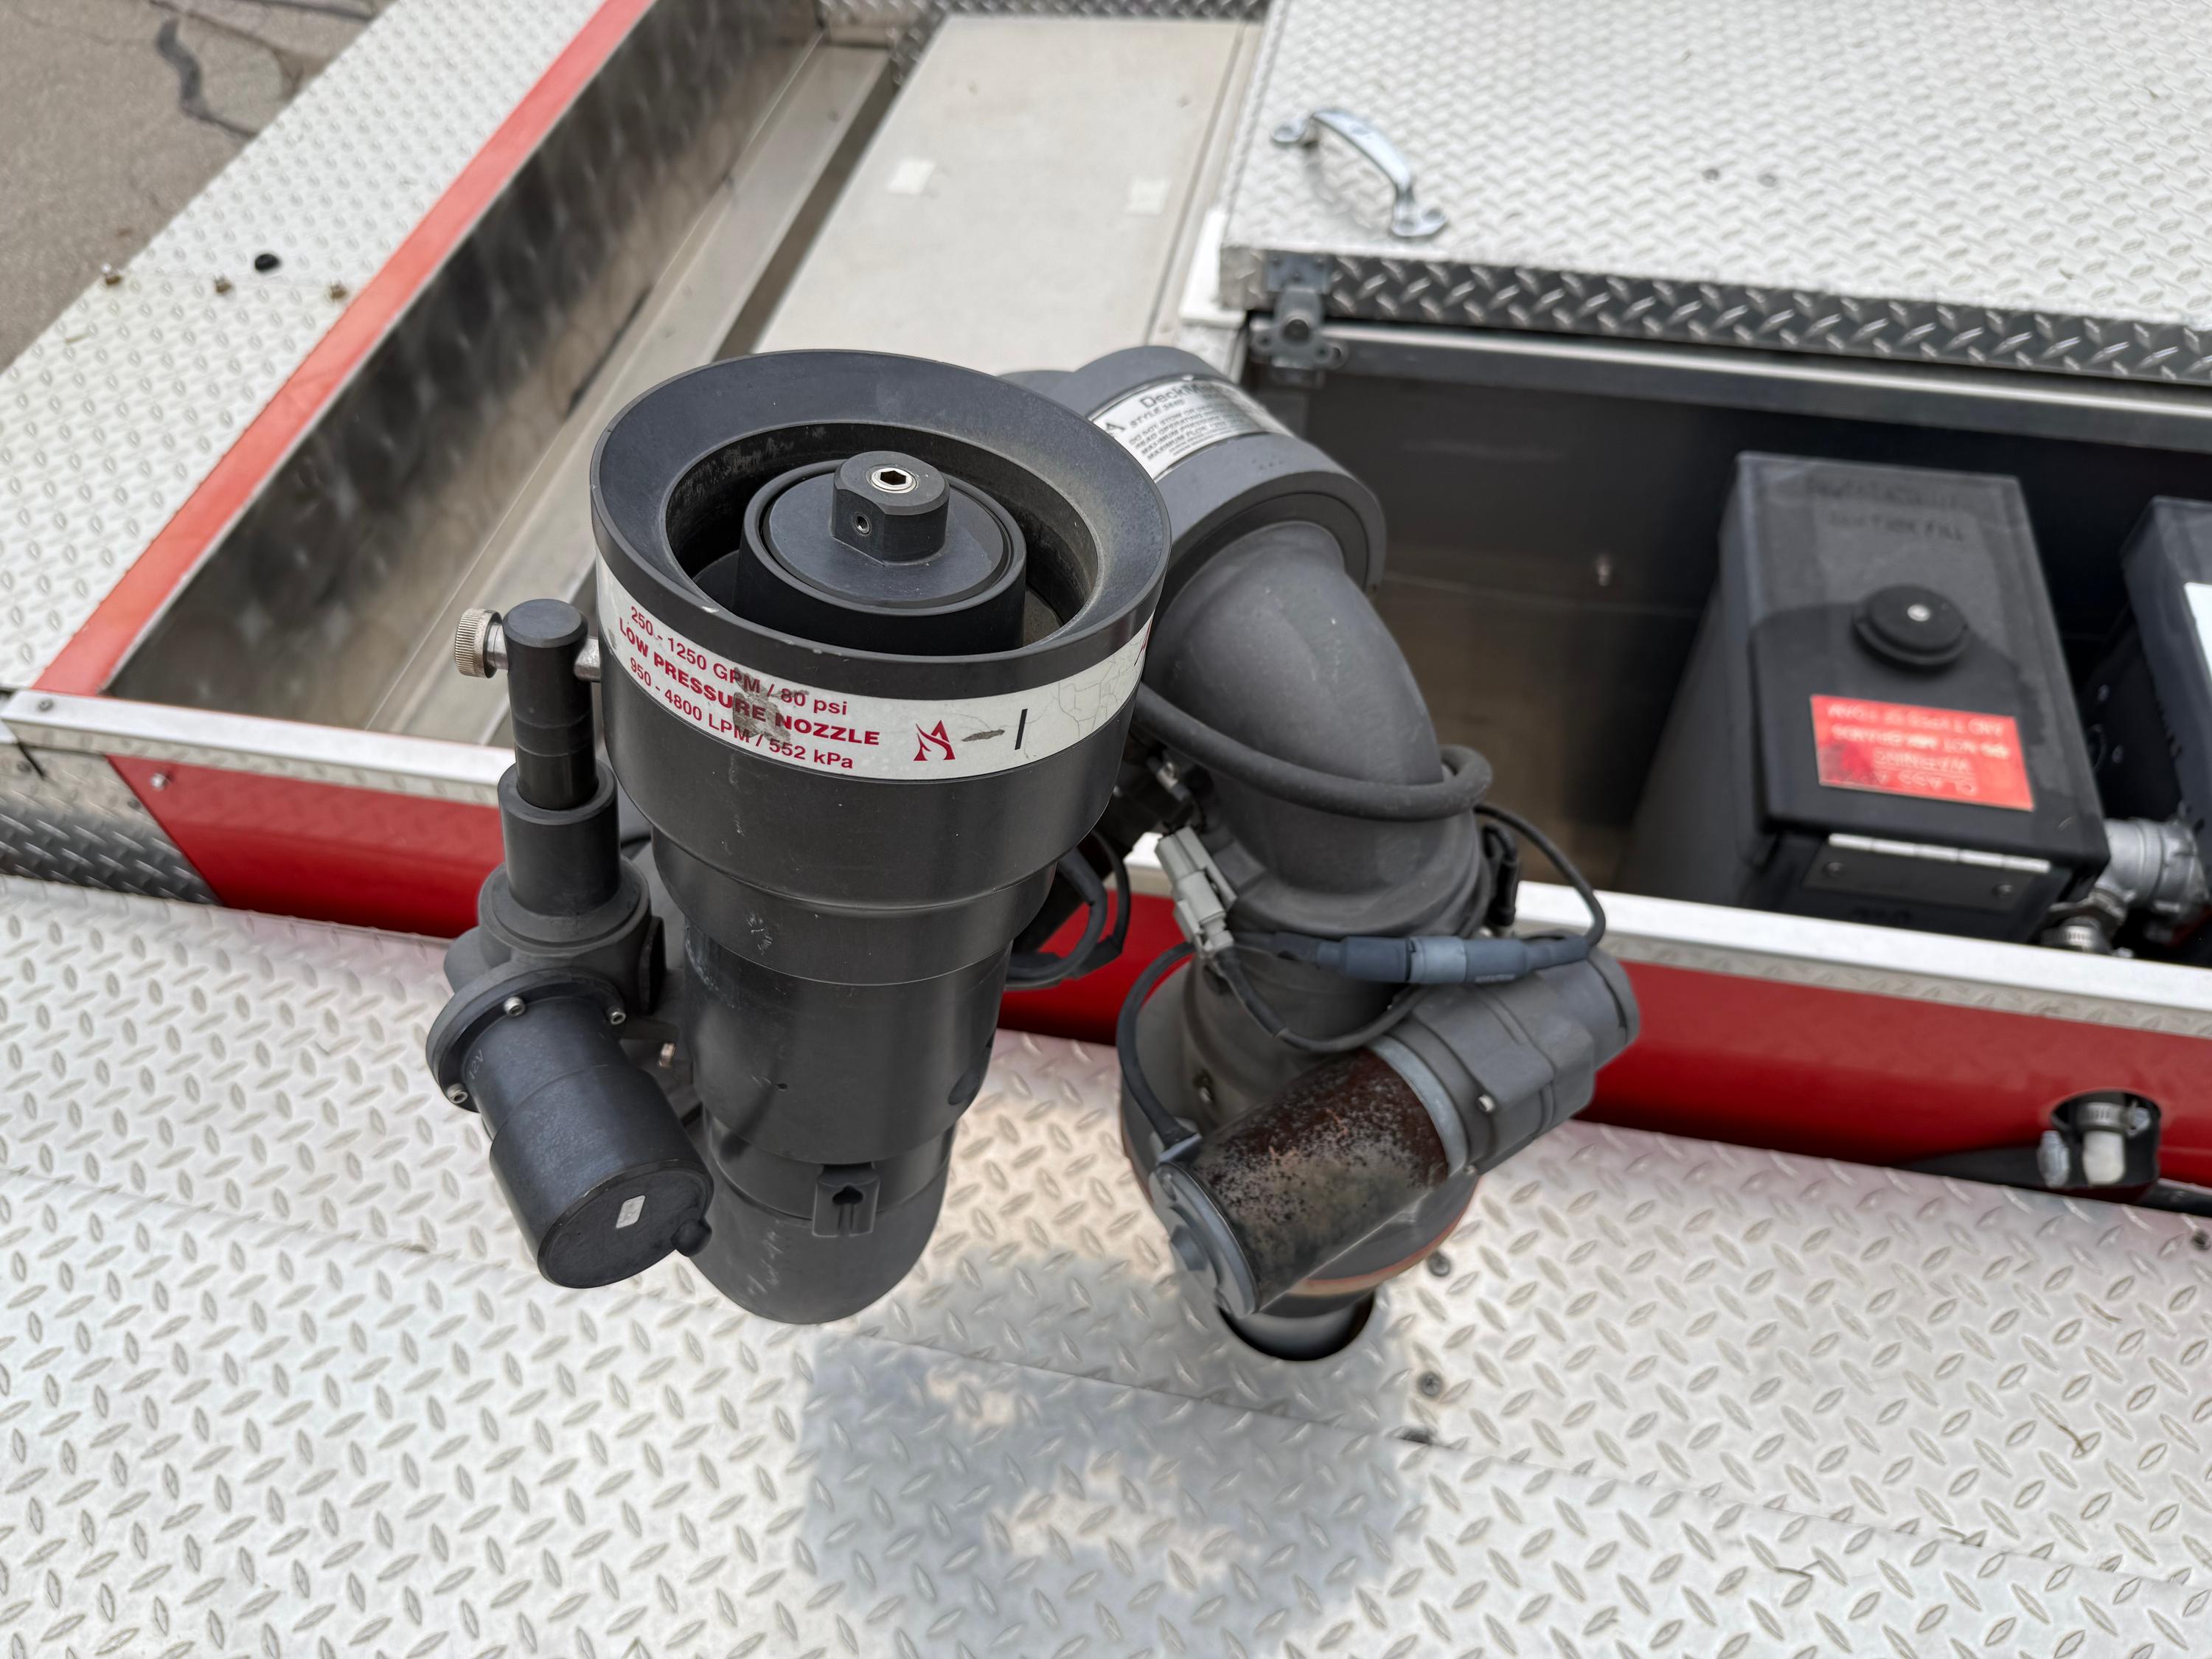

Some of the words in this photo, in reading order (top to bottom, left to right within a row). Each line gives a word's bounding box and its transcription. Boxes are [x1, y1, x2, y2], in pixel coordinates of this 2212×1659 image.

[619, 618, 649, 658] LOW
[654, 651, 766, 723] PRESSURE
[775, 713, 880, 746] NOZZLE
[630, 605, 655, 637] 250
[667, 636, 707, 670] 1250
[713, 664, 760, 695] GPM
[780, 687, 806, 707] 80
[813, 698, 848, 716] psi
[630, 656, 652, 687] 950
[664, 690, 703, 722] 4800
[708, 713, 751, 745] LPM
[769, 740, 806, 760] 552
[813, 748, 854, 769] kPa
